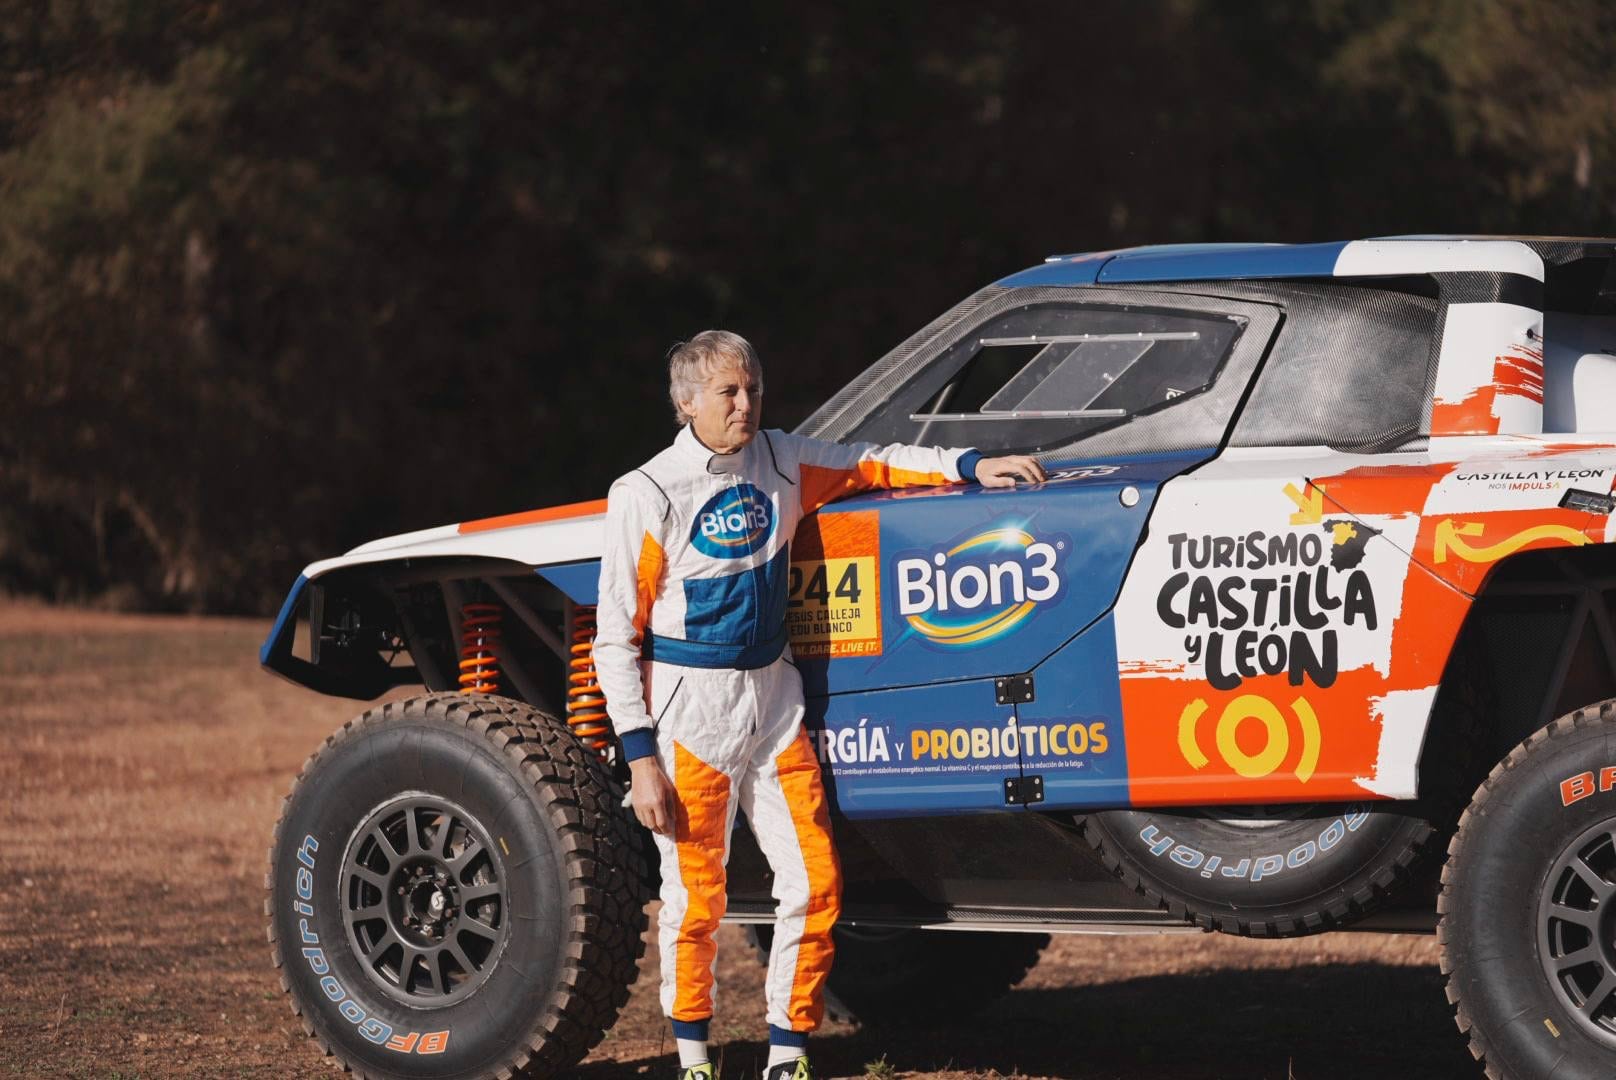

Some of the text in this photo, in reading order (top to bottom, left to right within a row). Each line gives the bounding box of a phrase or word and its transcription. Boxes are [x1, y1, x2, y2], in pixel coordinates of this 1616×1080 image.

[700, 504, 769, 537] Bion3
[788, 563, 862, 608] 244
[791, 622, 852, 636] EDU BLANCO
[817, 608, 861, 621] CALLEJA
[841, 642, 863, 653] LIVE
[865, 641, 877, 651] IT.
[1204, 623, 1339, 690] LEÓN
[894, 742, 905, 761] Y
[911, 716, 1109, 761] PROBIÓTICOS
